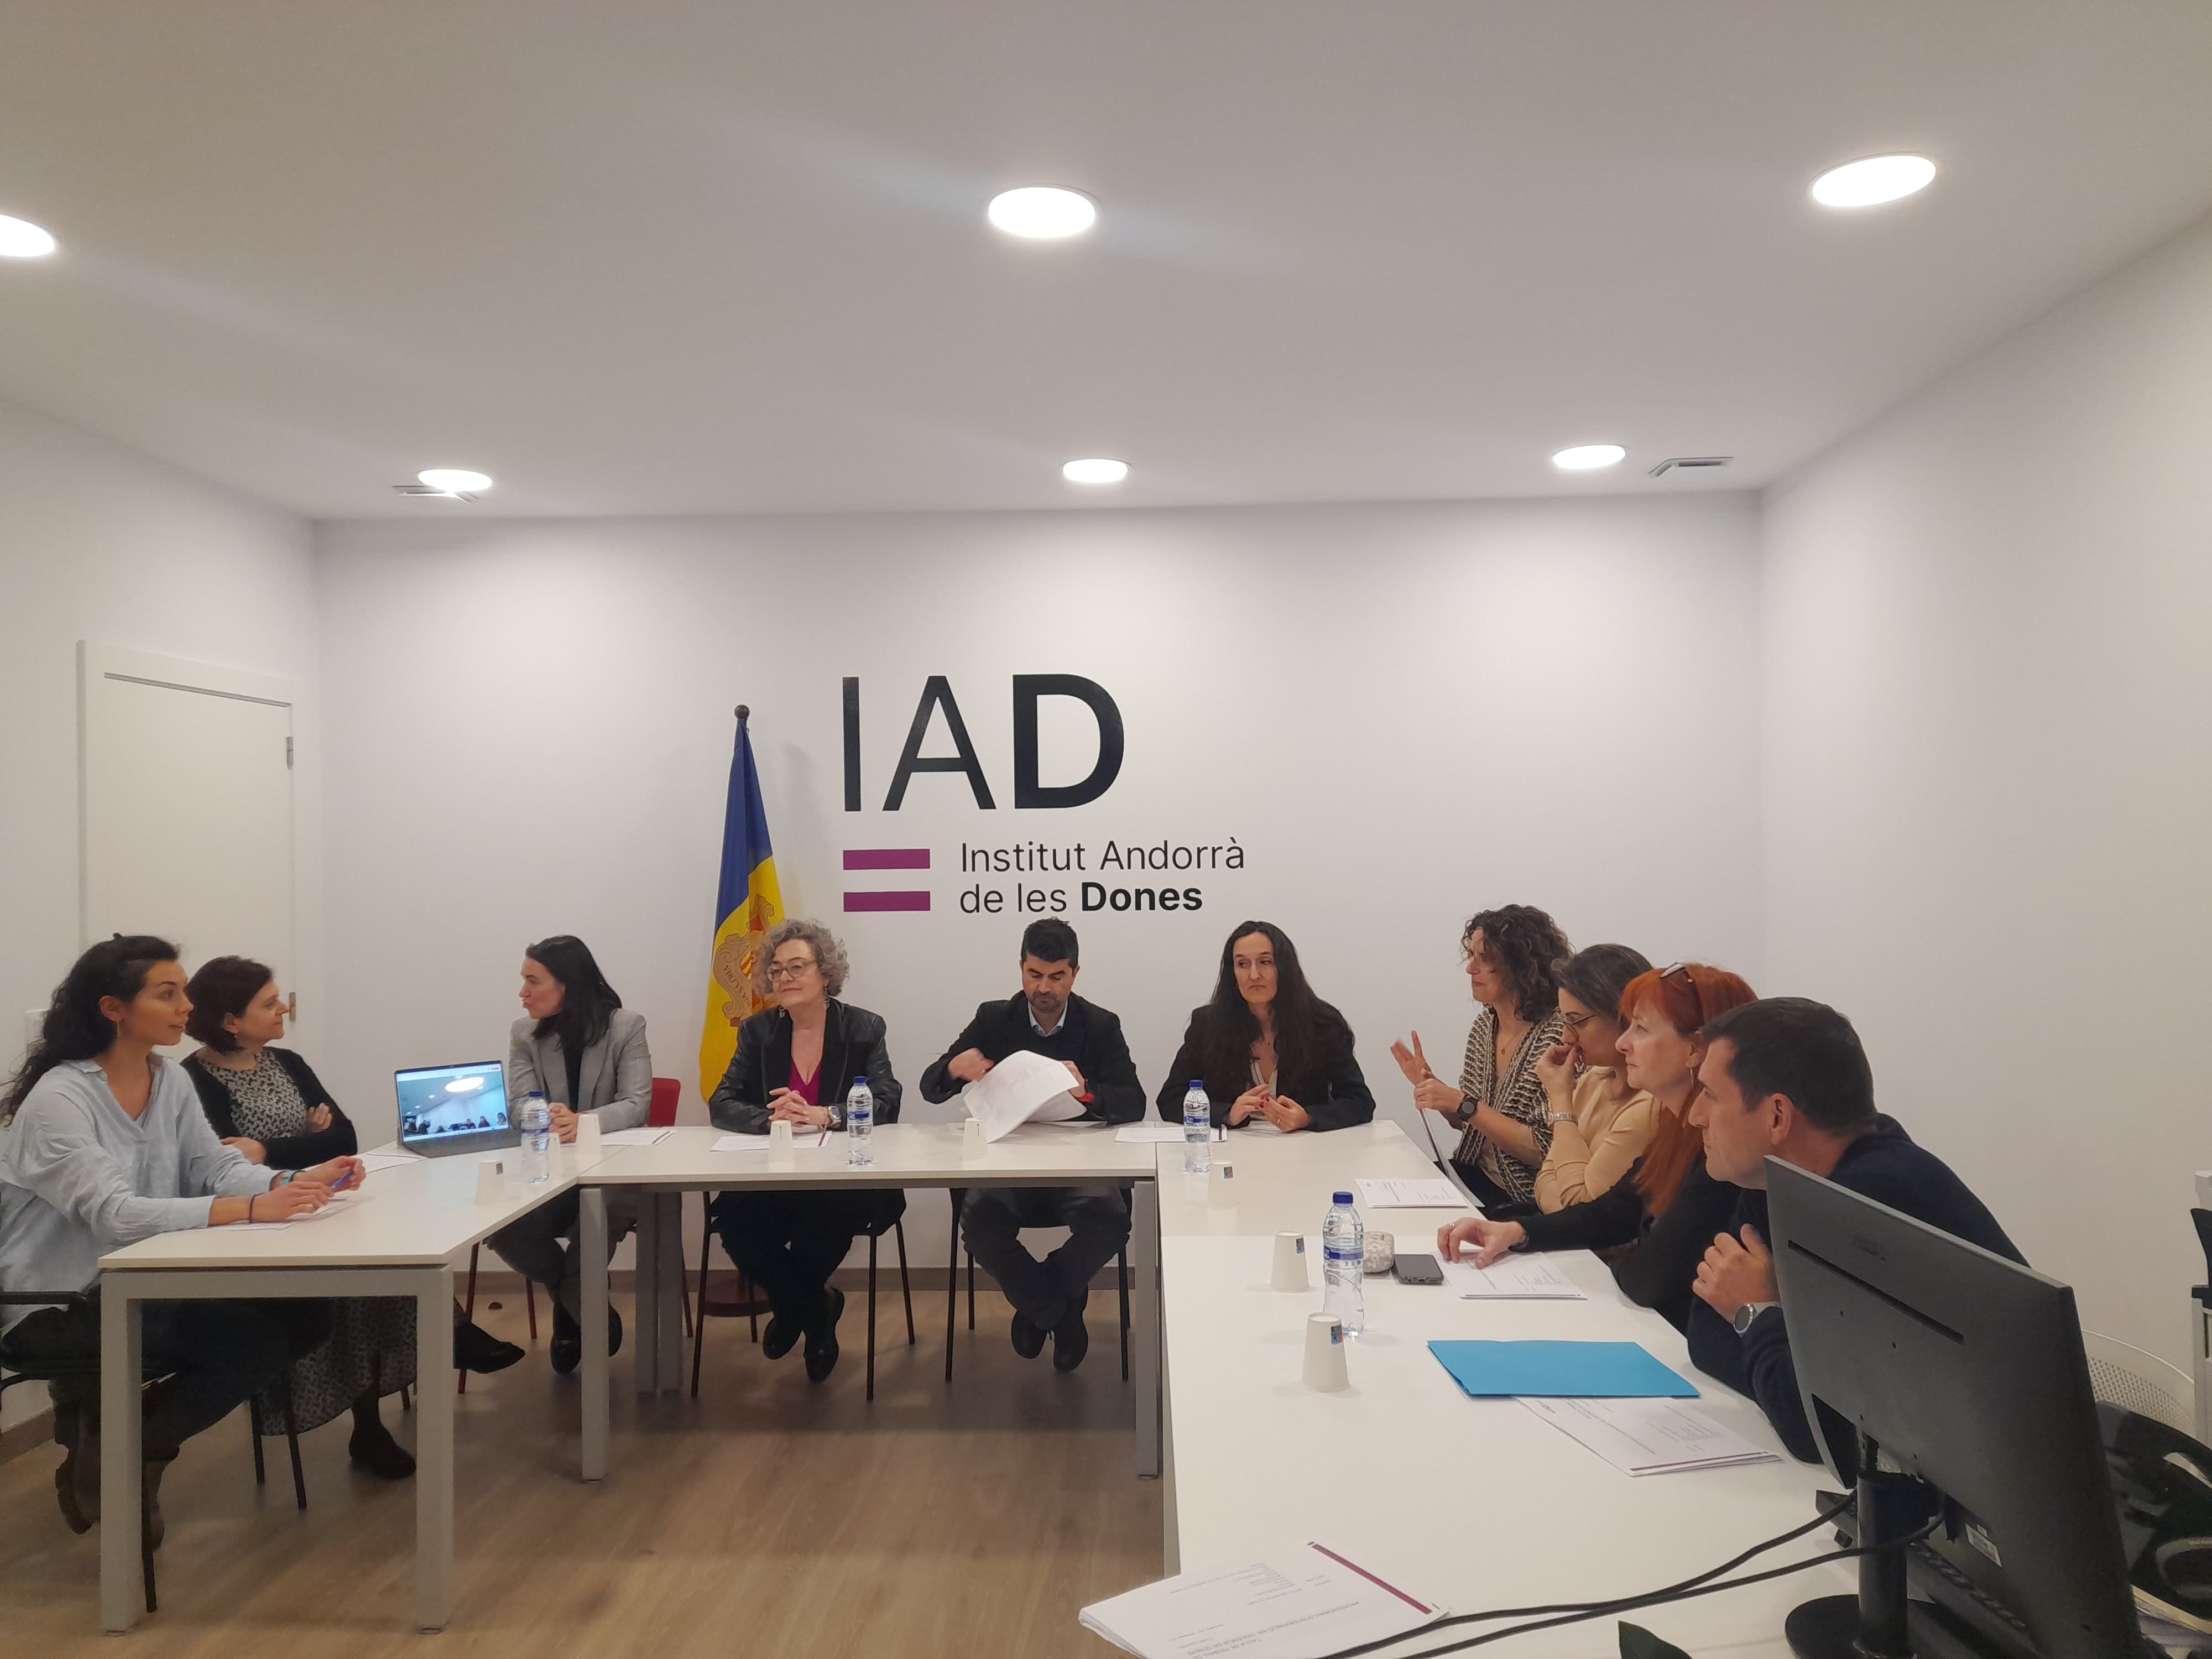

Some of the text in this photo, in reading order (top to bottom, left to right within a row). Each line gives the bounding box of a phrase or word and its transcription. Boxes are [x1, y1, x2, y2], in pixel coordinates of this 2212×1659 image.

[842, 674, 1124, 812] IAD
[962, 837, 1244, 872] Institut Andorrà
[960, 881, 1203, 914] de les Dones
